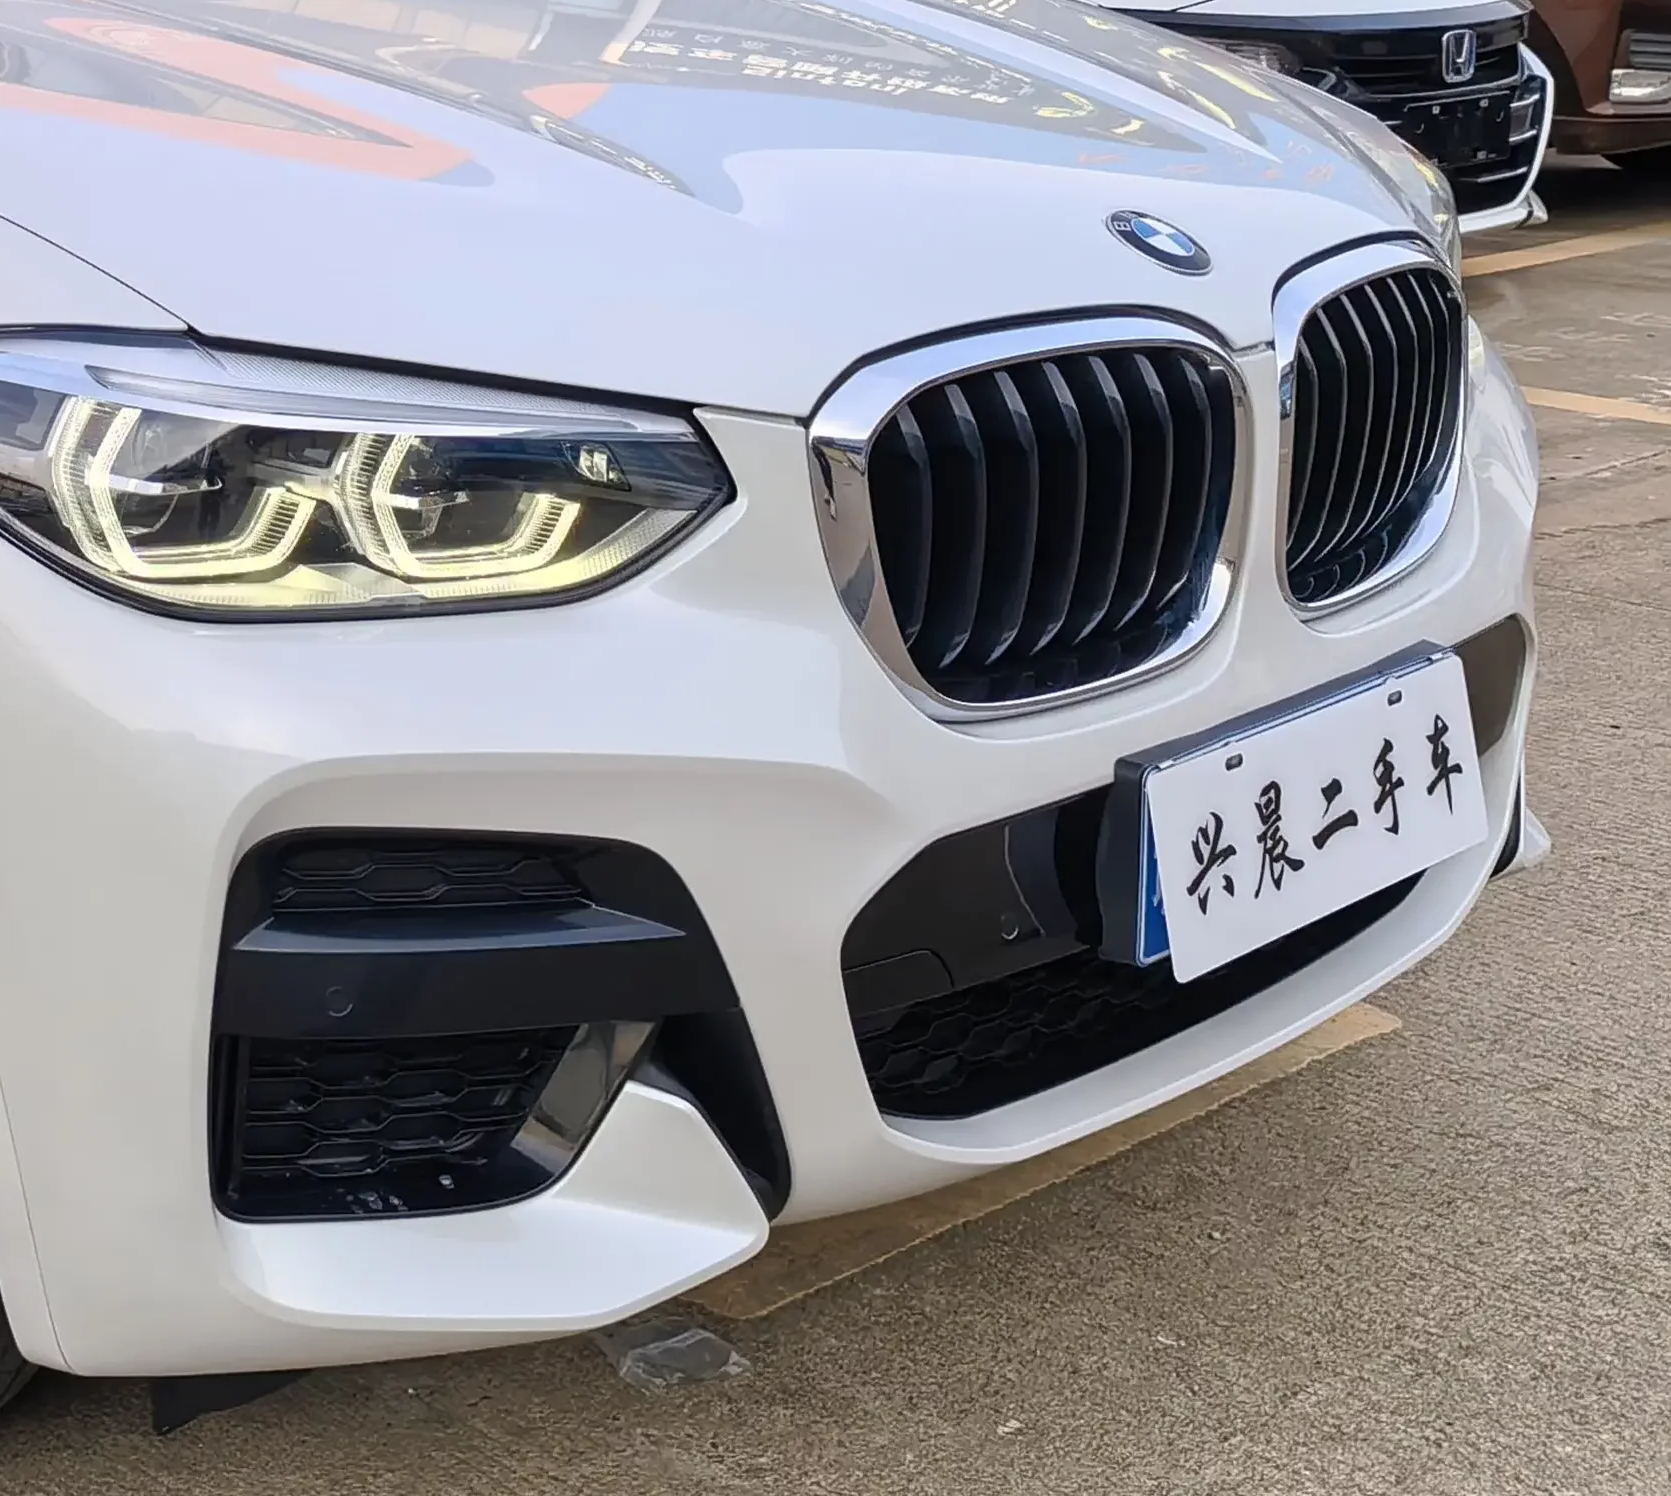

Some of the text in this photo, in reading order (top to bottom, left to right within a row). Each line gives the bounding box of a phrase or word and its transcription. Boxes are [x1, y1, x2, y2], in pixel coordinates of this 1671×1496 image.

[1186, 714, 1463, 915] 兴晨二手车
